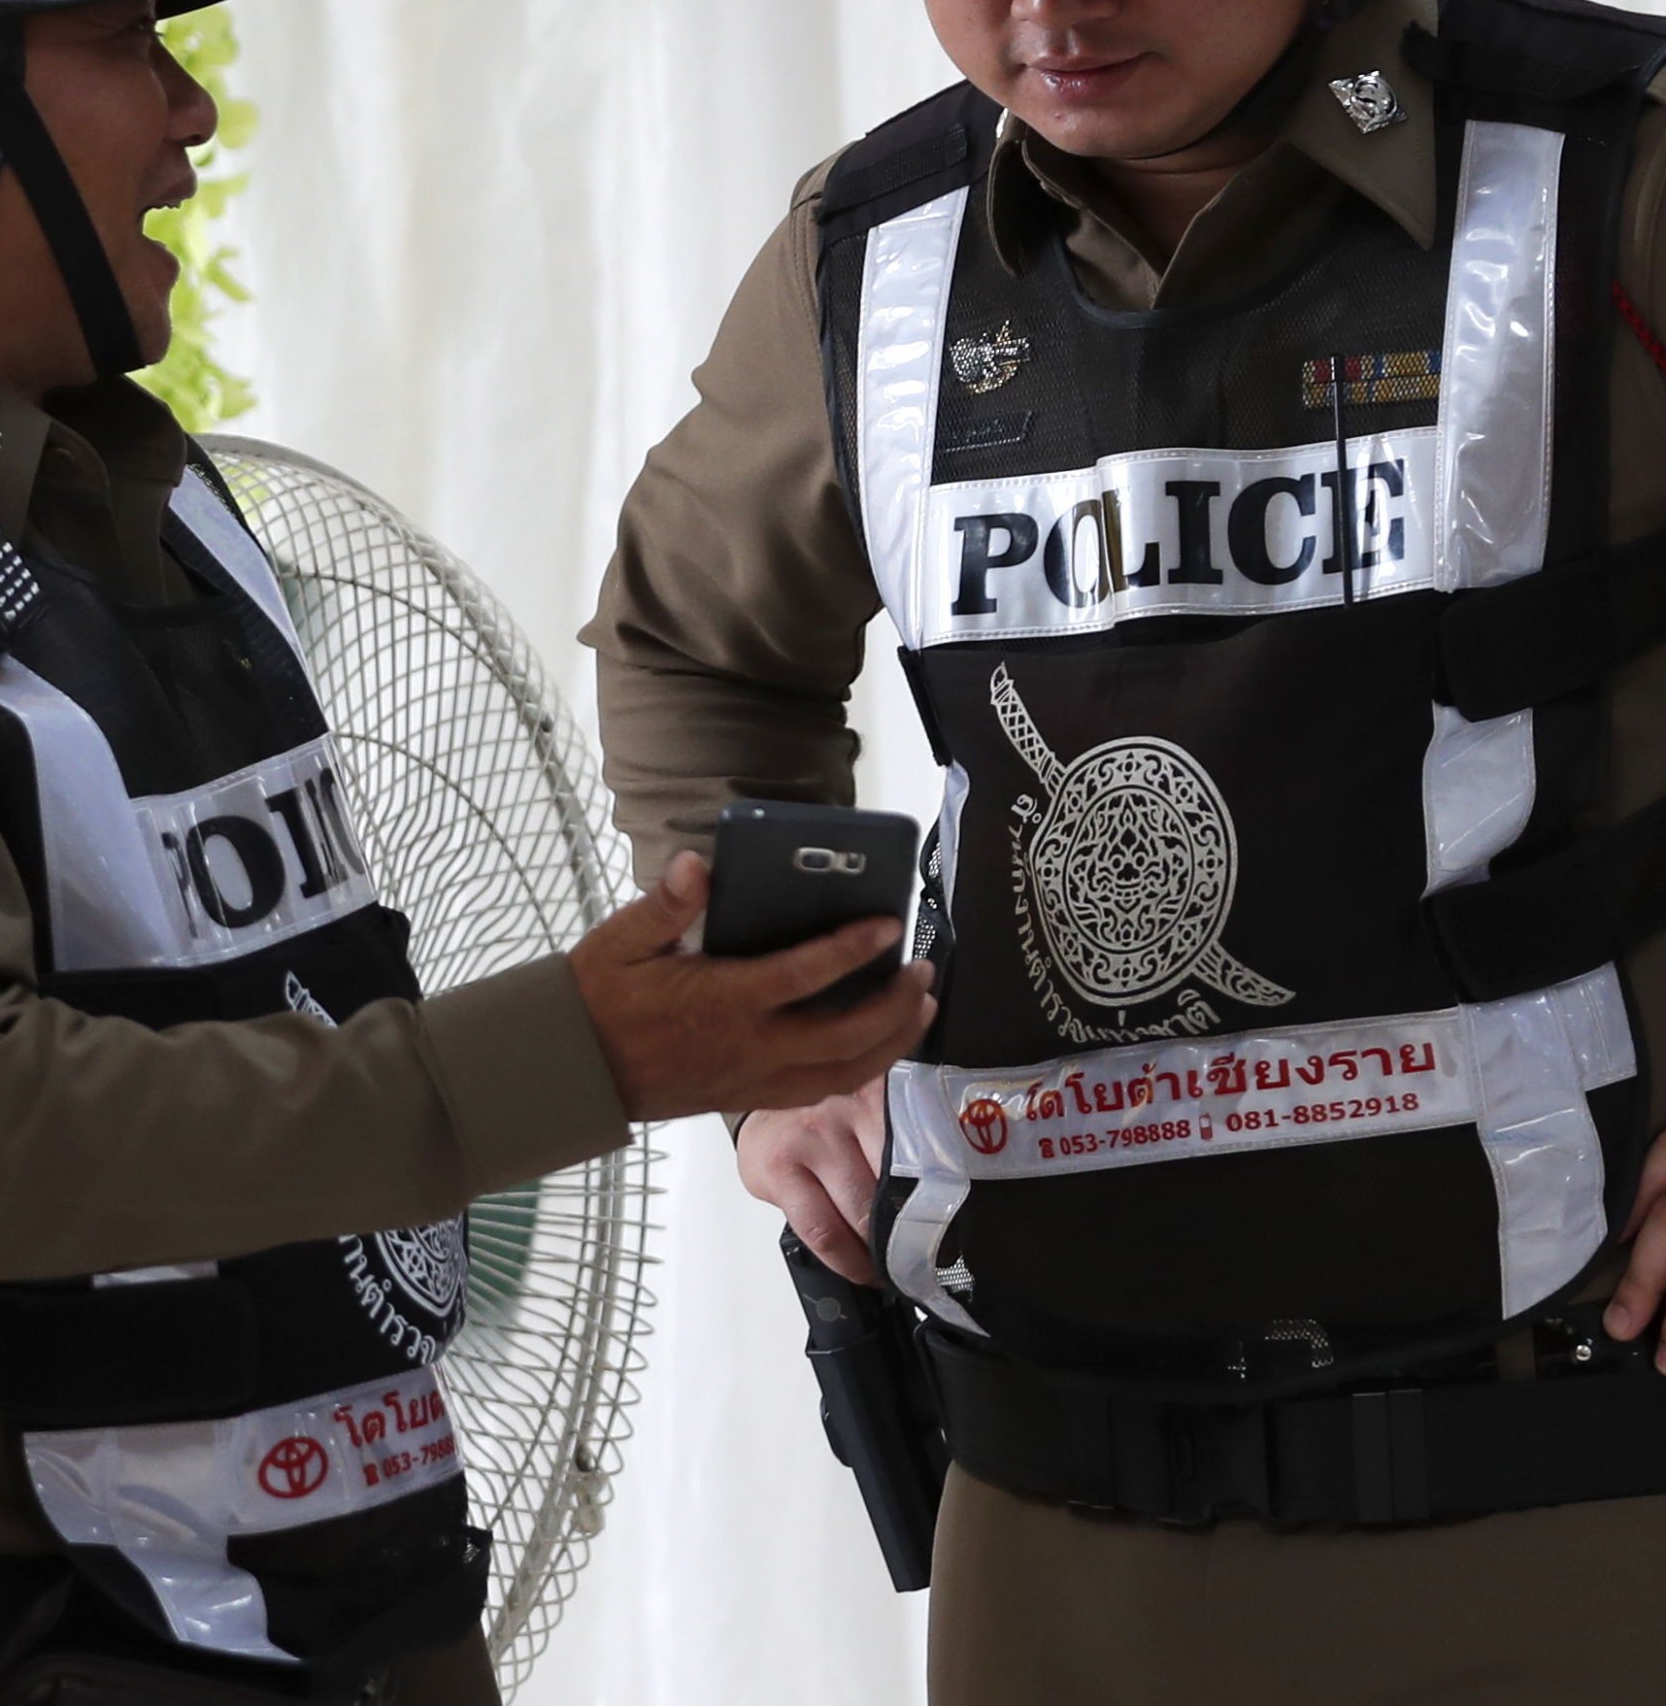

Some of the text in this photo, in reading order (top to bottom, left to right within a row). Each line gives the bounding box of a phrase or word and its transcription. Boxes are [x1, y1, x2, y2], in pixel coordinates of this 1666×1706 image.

[951, 458, 1406, 616] POLICE
[1025, 1041, 1437, 1121] โตโยต้าเชียงราย
[1060, 1092, 1420, 1156] 053-798888 081-8852918
